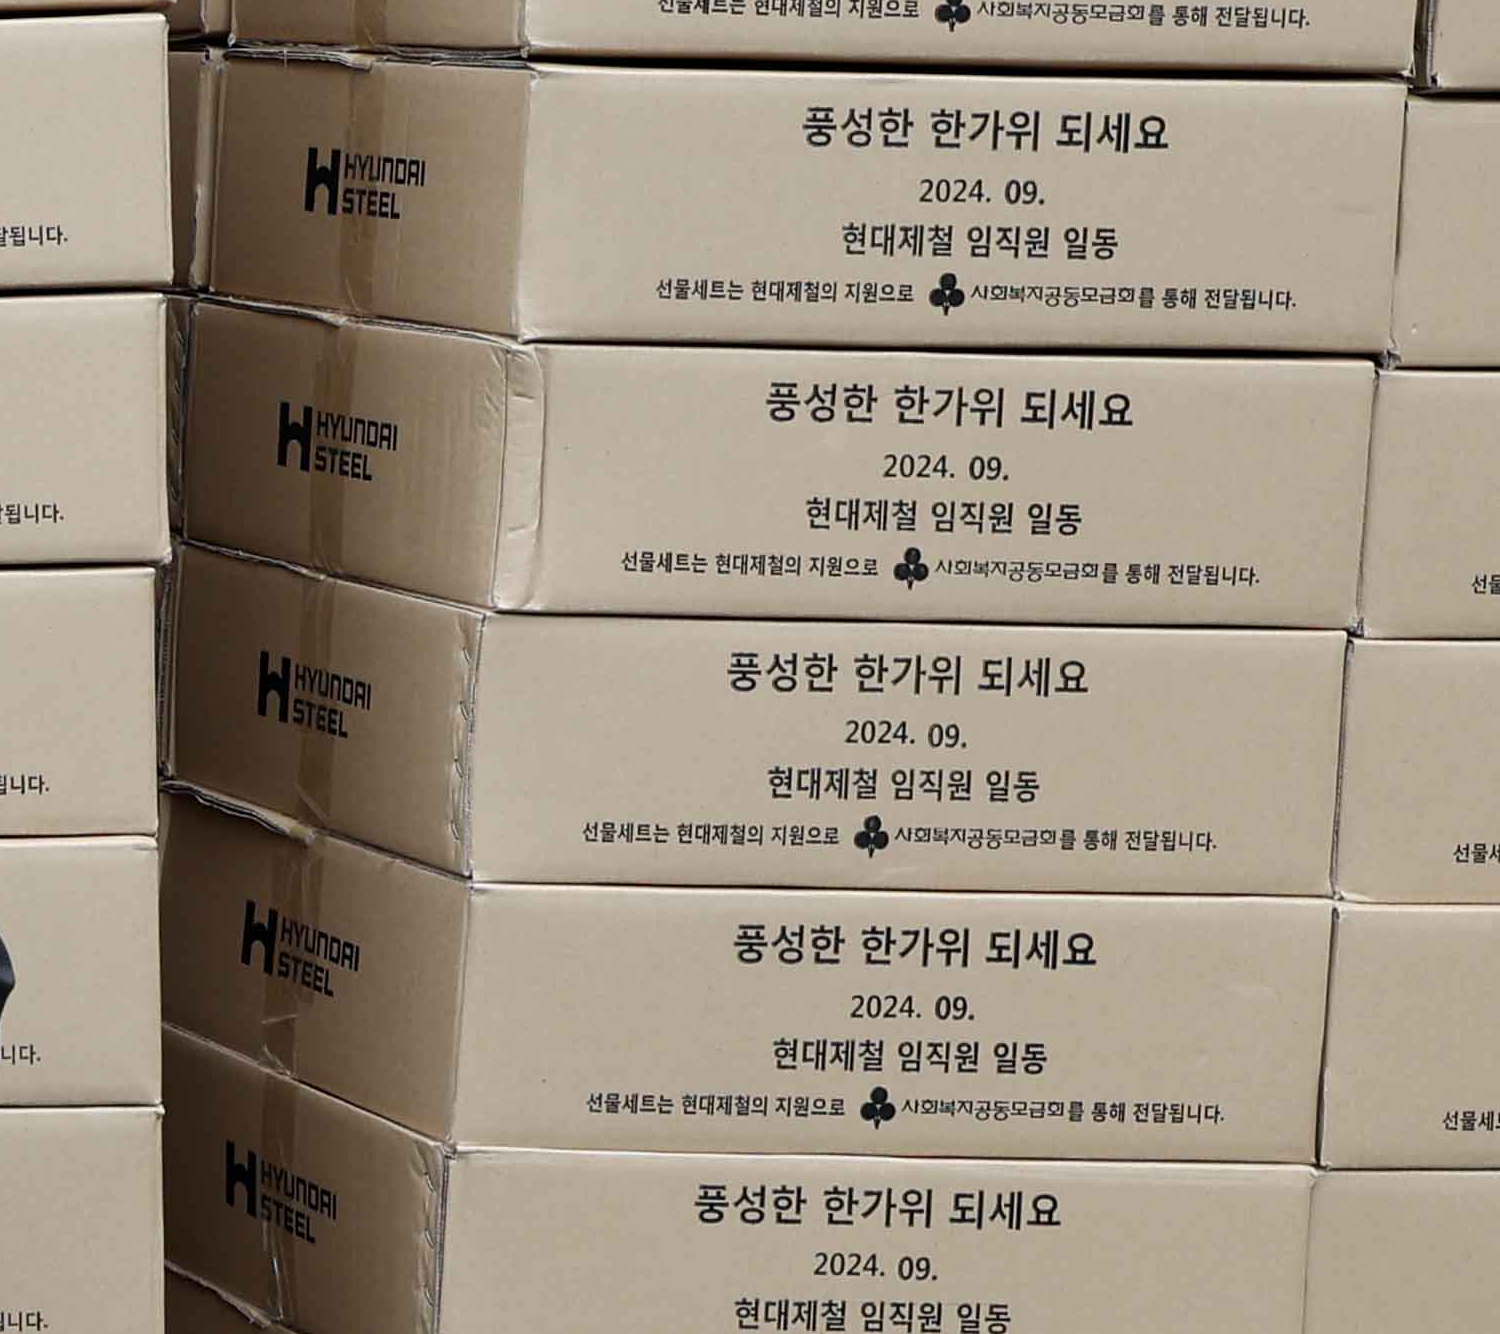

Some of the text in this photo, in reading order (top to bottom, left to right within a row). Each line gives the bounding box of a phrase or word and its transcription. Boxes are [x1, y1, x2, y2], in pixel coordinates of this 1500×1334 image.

[315, 410, 399, 453] HYUNDAI
[313, 445, 374, 483] STEEL
[260, 1159, 338, 1220] HYUNDAI
[260, 1194, 317, 1245] STEEL
